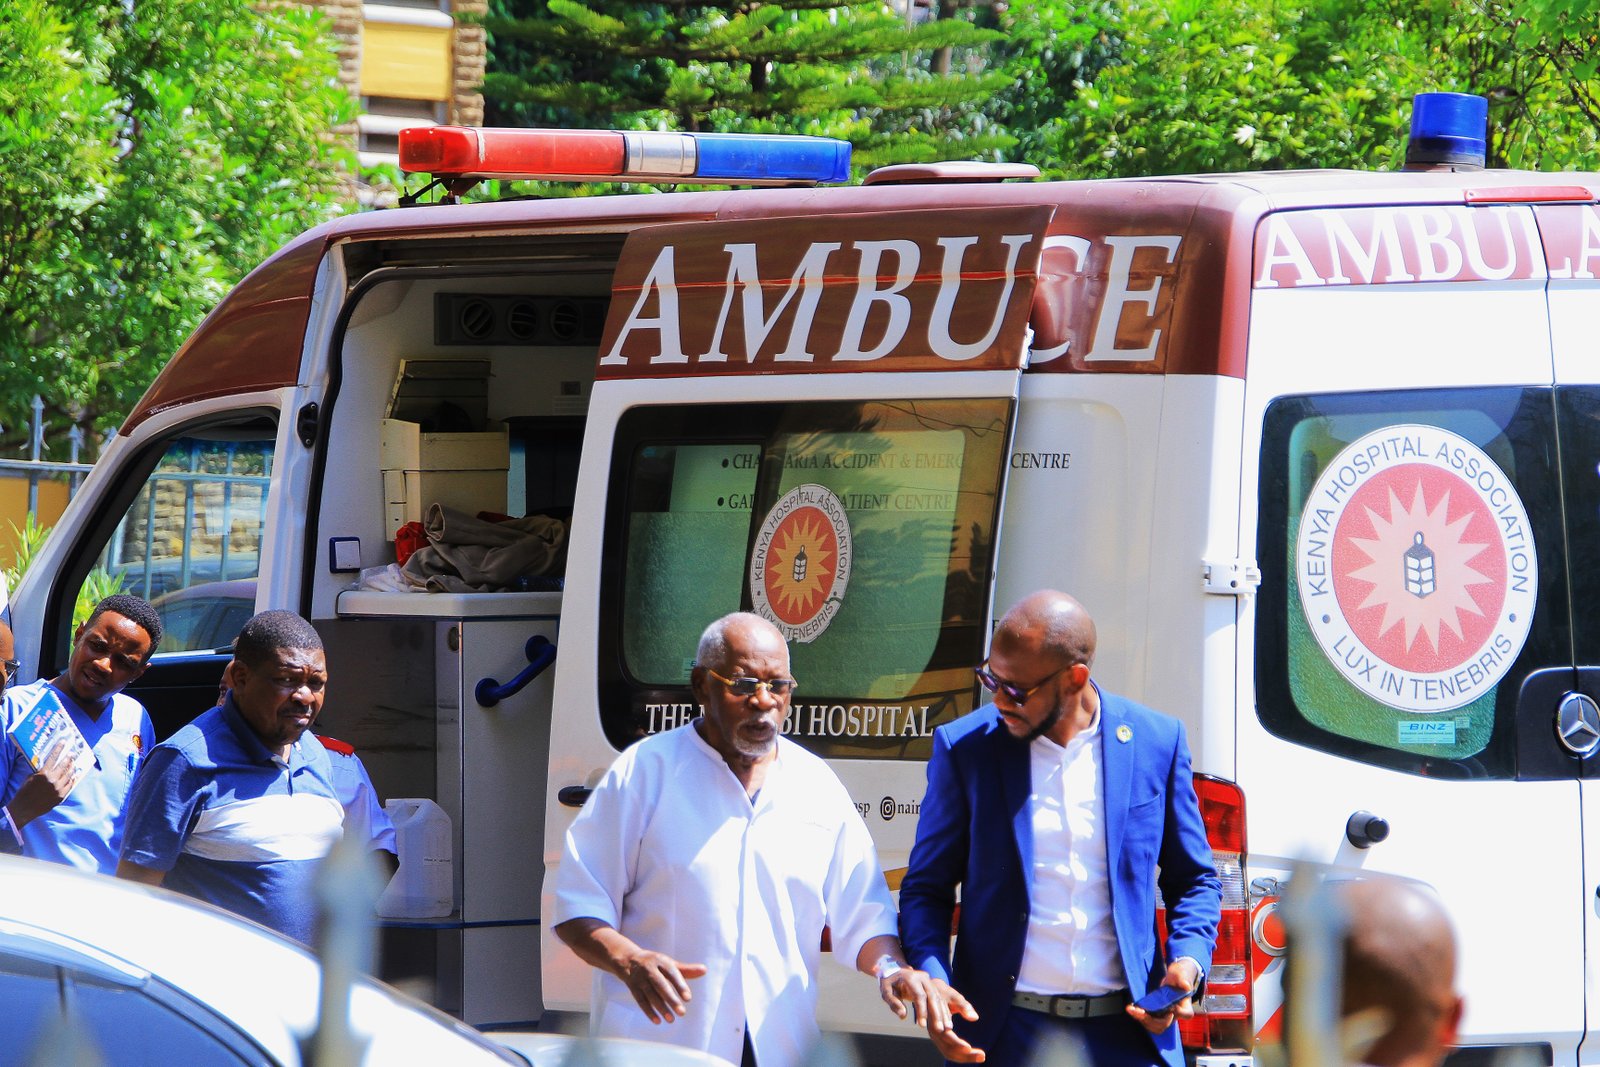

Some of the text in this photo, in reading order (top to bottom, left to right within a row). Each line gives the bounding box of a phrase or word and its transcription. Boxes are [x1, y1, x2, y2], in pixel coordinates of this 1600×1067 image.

[822, 453, 896, 469] ACCIDENT
[1010, 453, 1071, 469] CENTRE
[894, 494, 952, 509] CENTRE
[1307, 436, 1528, 597] KENYA HOSPITAL ASSOCIATION
[755, 491, 848, 581] KENYA HOSPITAL ASSOCIATION
[787, 604, 833, 640] TENEBRIS
[1333, 634, 1513, 700] LUX IN TENEBRIS
[646, 704, 693, 734] THE
[808, 705, 934, 737] HOSPITAL
[1409, 723, 1446, 731] BINZ
